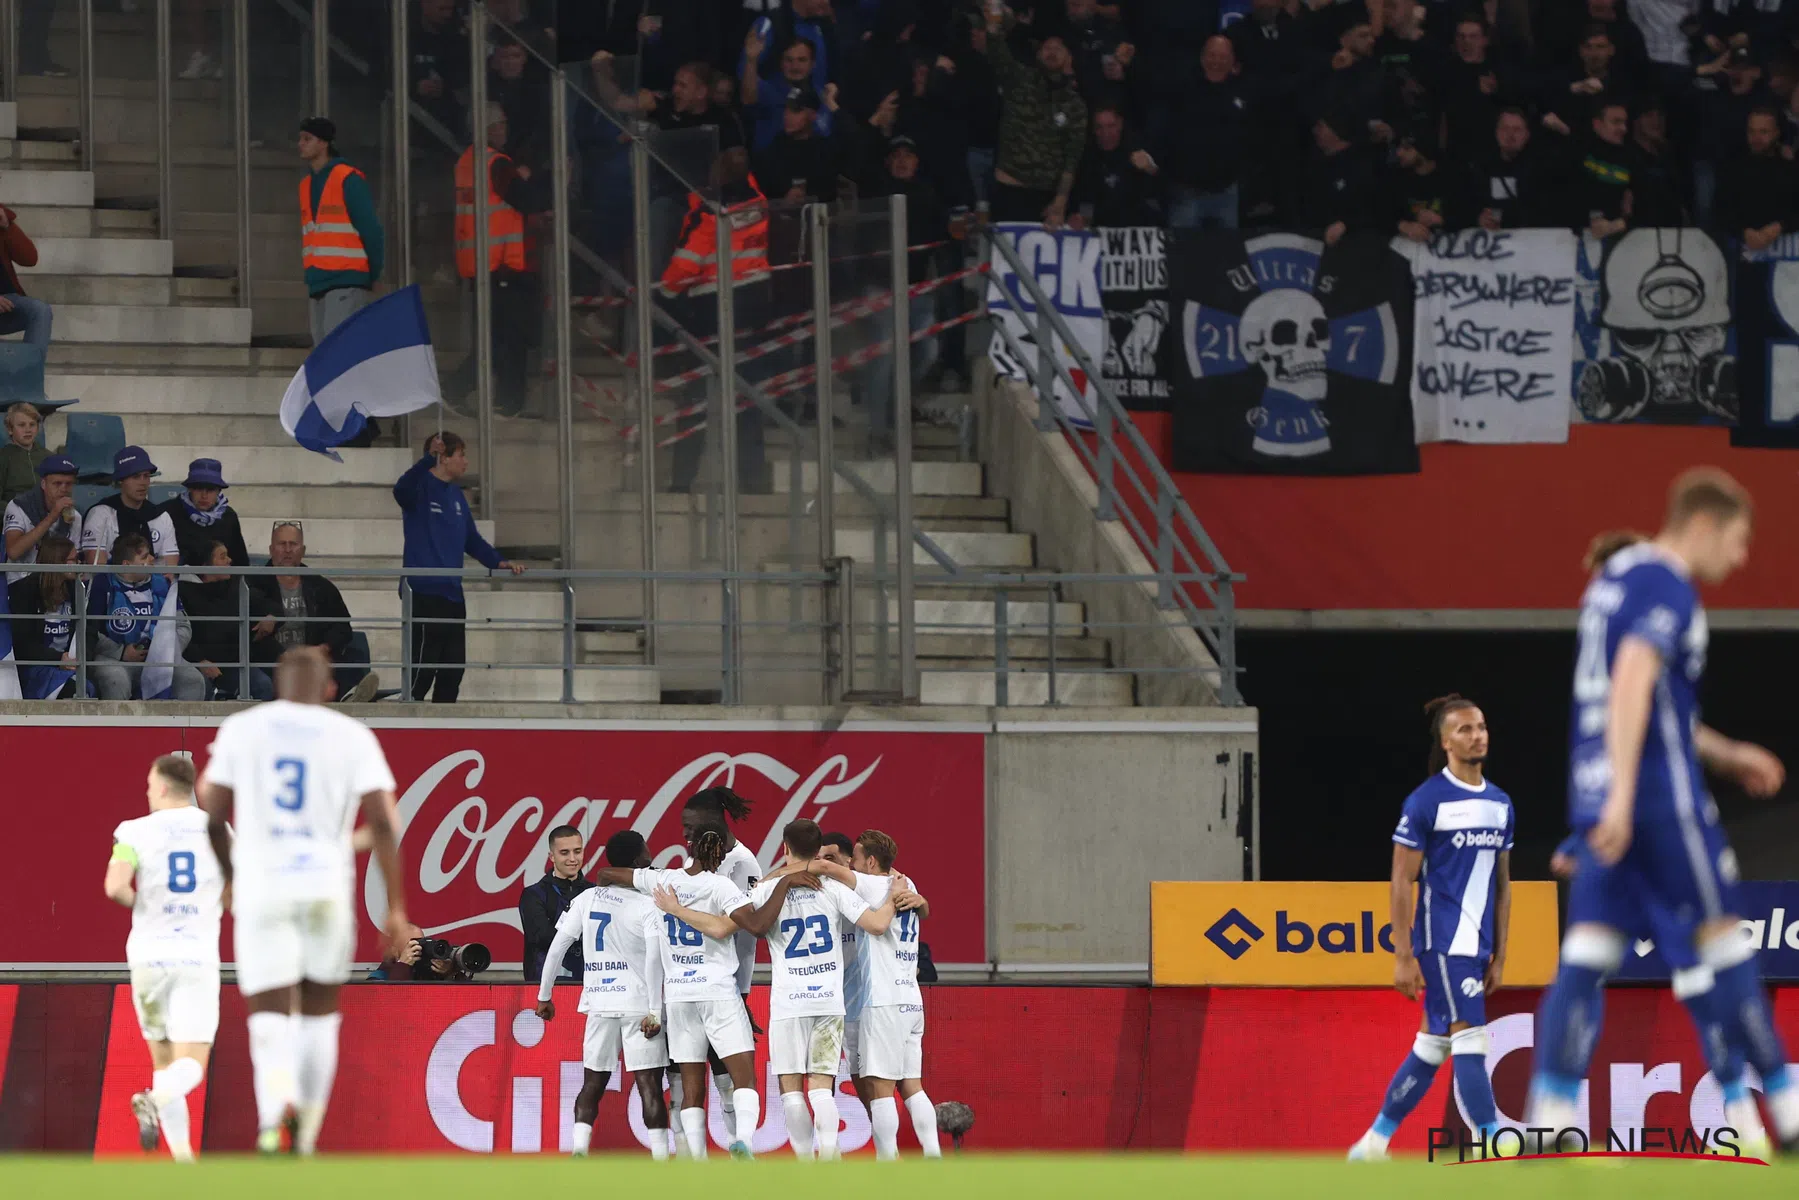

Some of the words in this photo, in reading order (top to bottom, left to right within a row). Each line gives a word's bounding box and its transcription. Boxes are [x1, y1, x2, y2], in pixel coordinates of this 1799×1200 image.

[1101, 229, 1166, 255] WAYS
[1103, 259, 1134, 287] ITH
[1143, 257, 1166, 286] US
[1227, 259, 1335, 293] Ultras
[1201, 322, 1236, 361] 21
[1344, 325, 1366, 361] 7
[1434, 315, 1552, 355] JUSTICE
[1246, 407, 1331, 436] Genk
[274, 756, 307, 812] 3
[364, 748, 884, 936] Coca-Cl
[168, 851, 197, 893] 8
[589, 911, 612, 952] 7
[663, 912, 704, 947] 18
[780, 914, 834, 960] 23
[605, 961, 628, 970] BAAH
[788, 961, 837, 976] STEUCKERS
[788, 990, 834, 1000] CARGLASS
